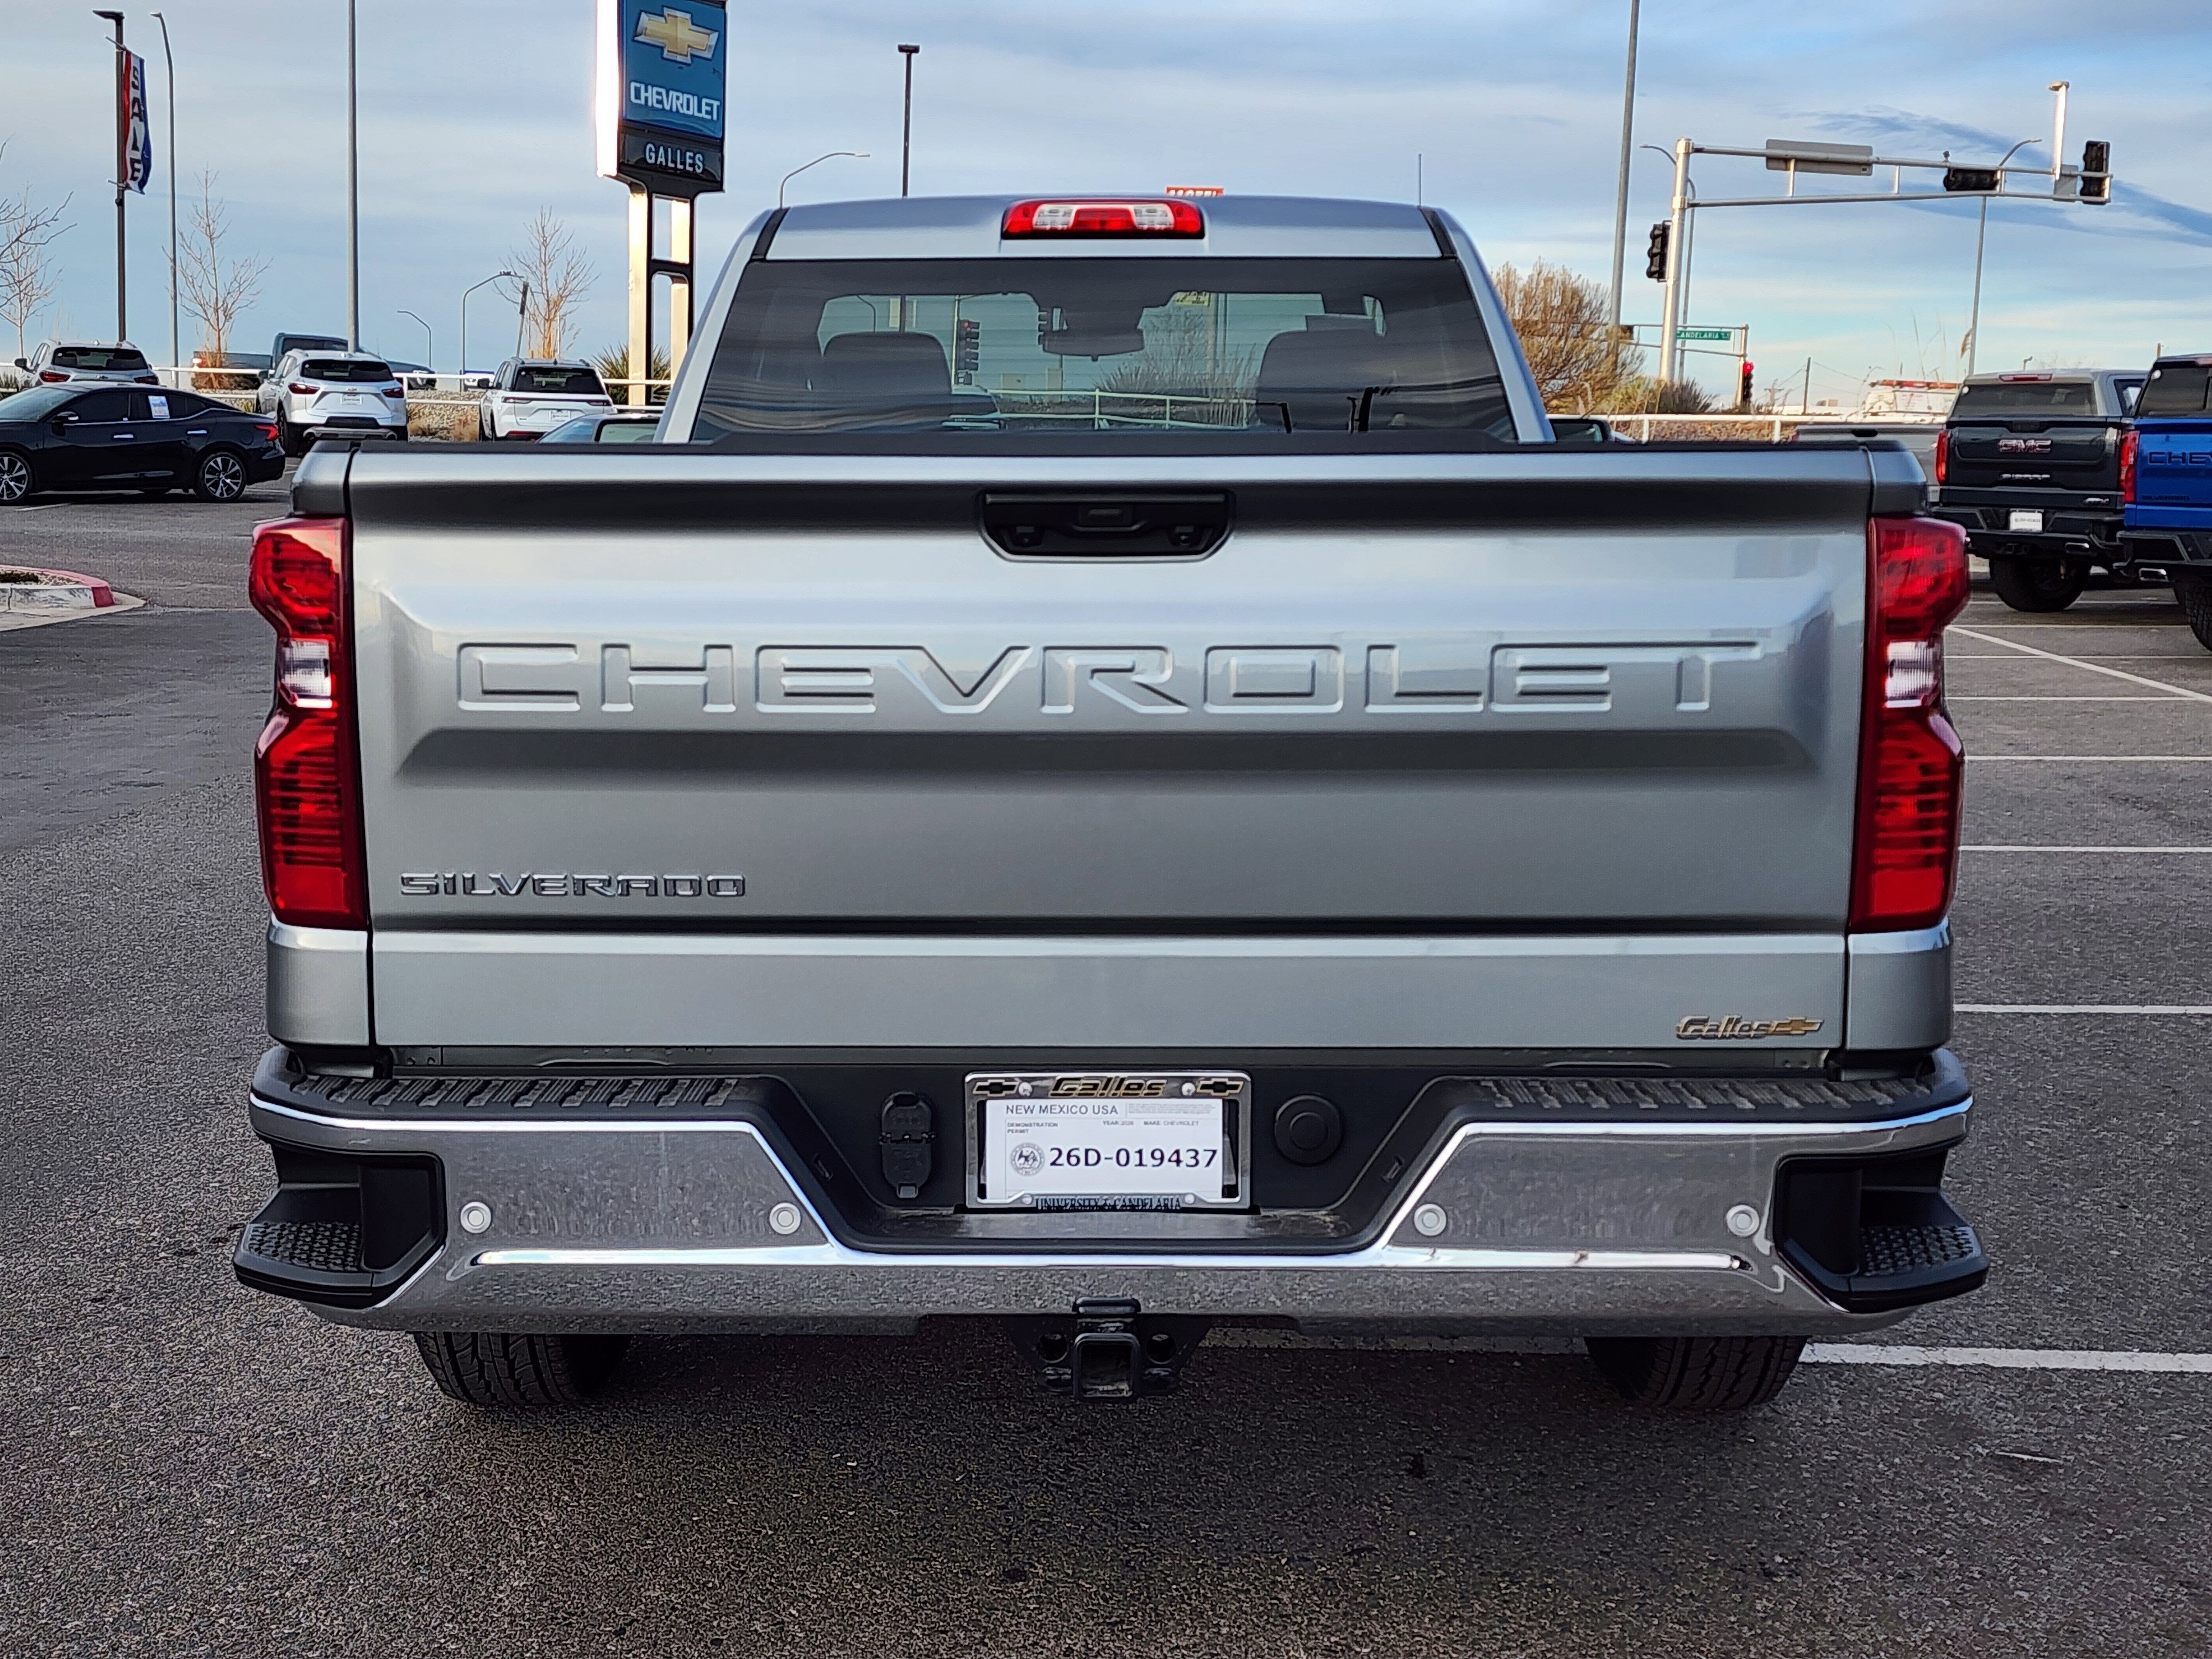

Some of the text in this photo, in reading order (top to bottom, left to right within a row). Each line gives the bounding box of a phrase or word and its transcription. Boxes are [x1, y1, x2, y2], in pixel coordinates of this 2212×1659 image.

[630, 81, 720, 121] CHEVROLET
[131, 65, 144, 181] SALE
[645, 143, 703, 174] GALLES
[1998, 440, 2052, 453] GMC
[2148, 451, 2212, 466] CHE
[457, 643, 1762, 713] CHEVROLET
[400, 872, 746, 897] SILVERADO
[1676, 1014, 1772, 1040] Galles
[1048, 1076, 1168, 1097] Galles
[1006, 1105, 1035, 1114] NEW
[1039, 1104, 1088, 1115] MEXICO
[1092, 1105, 1119, 1115] USA
[1049, 1147, 1218, 1168] 26D-019437
